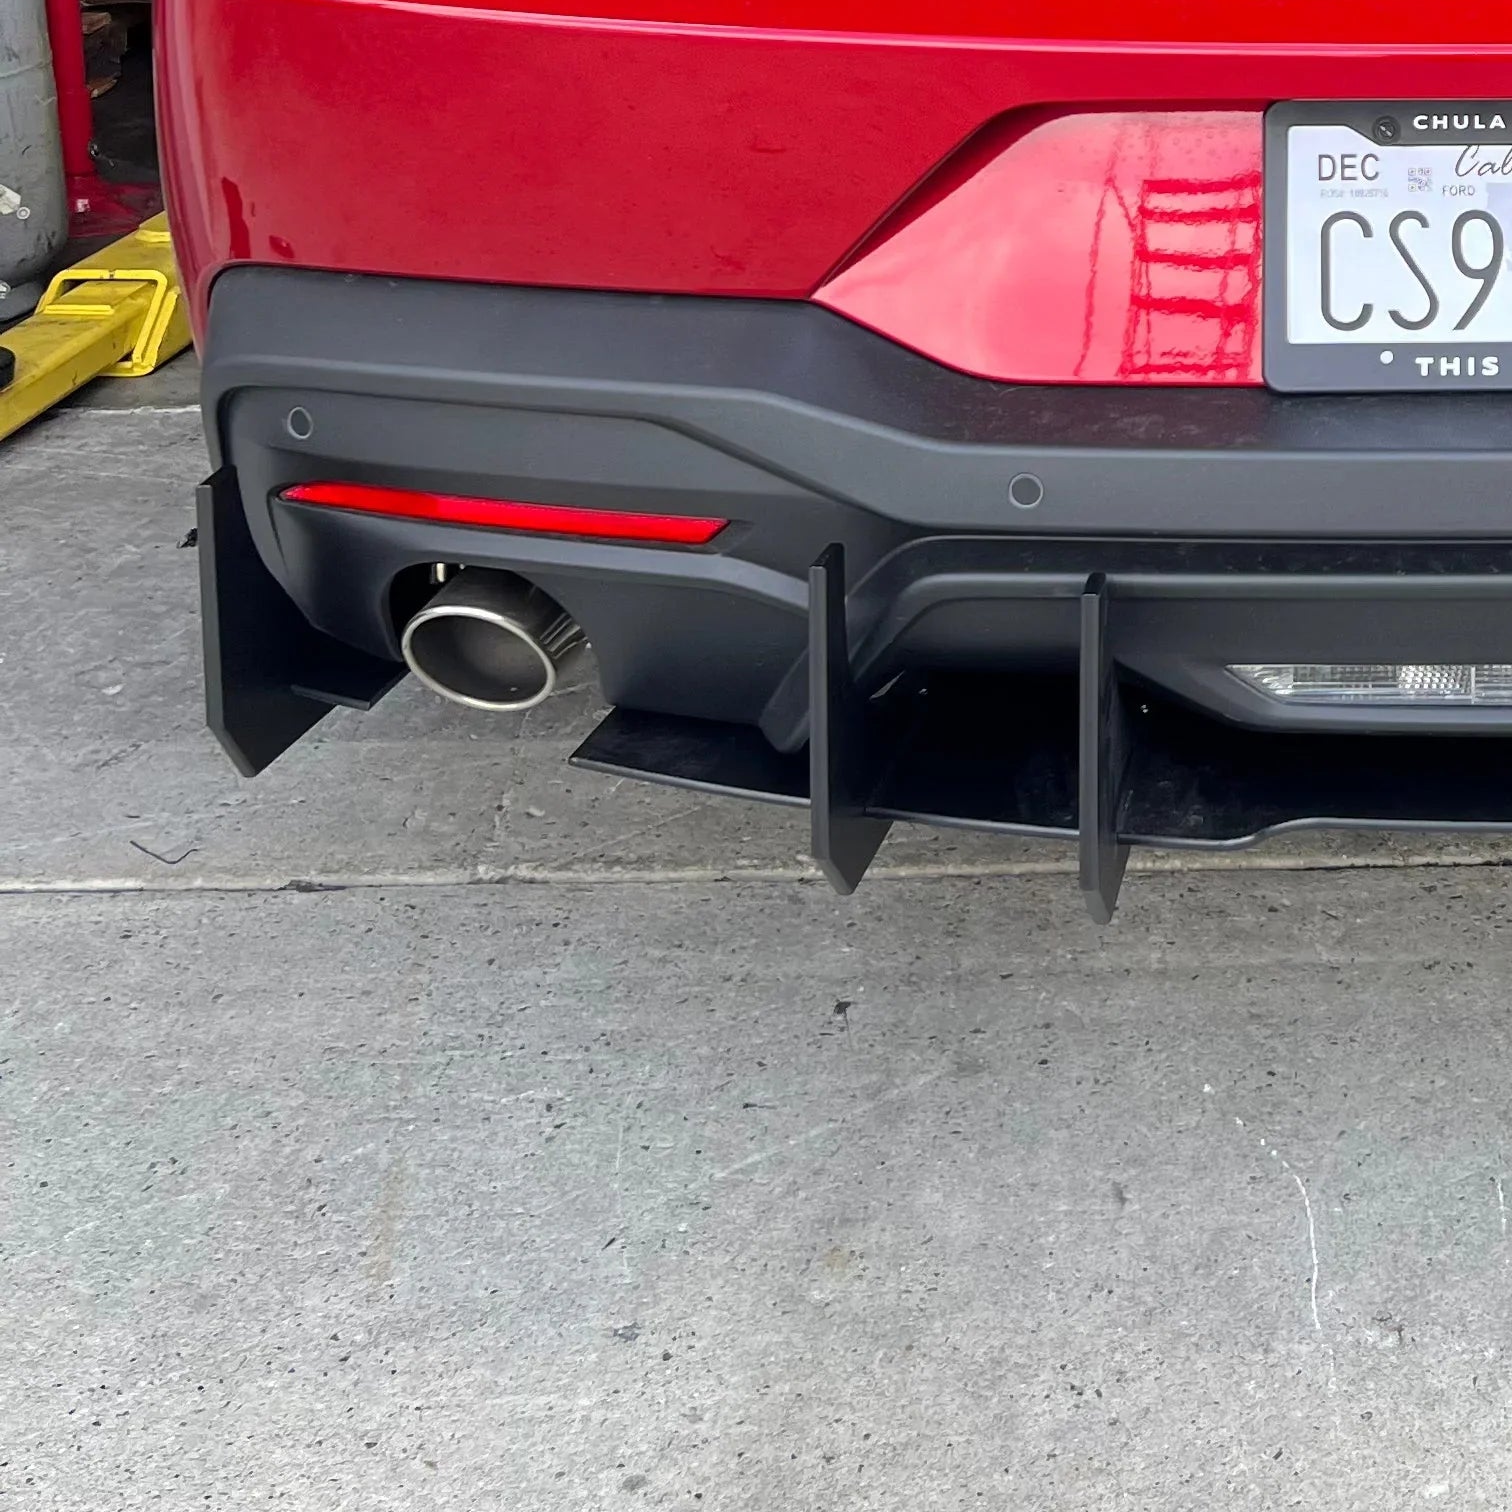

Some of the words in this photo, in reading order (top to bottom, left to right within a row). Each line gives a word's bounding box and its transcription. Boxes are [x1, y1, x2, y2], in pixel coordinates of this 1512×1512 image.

[1412, 113, 1506, 130] CHULA
[1317, 152, 1380, 181] DEC
[1442, 185, 1476, 196] FORD
[1414, 355, 1500, 377] THIS
